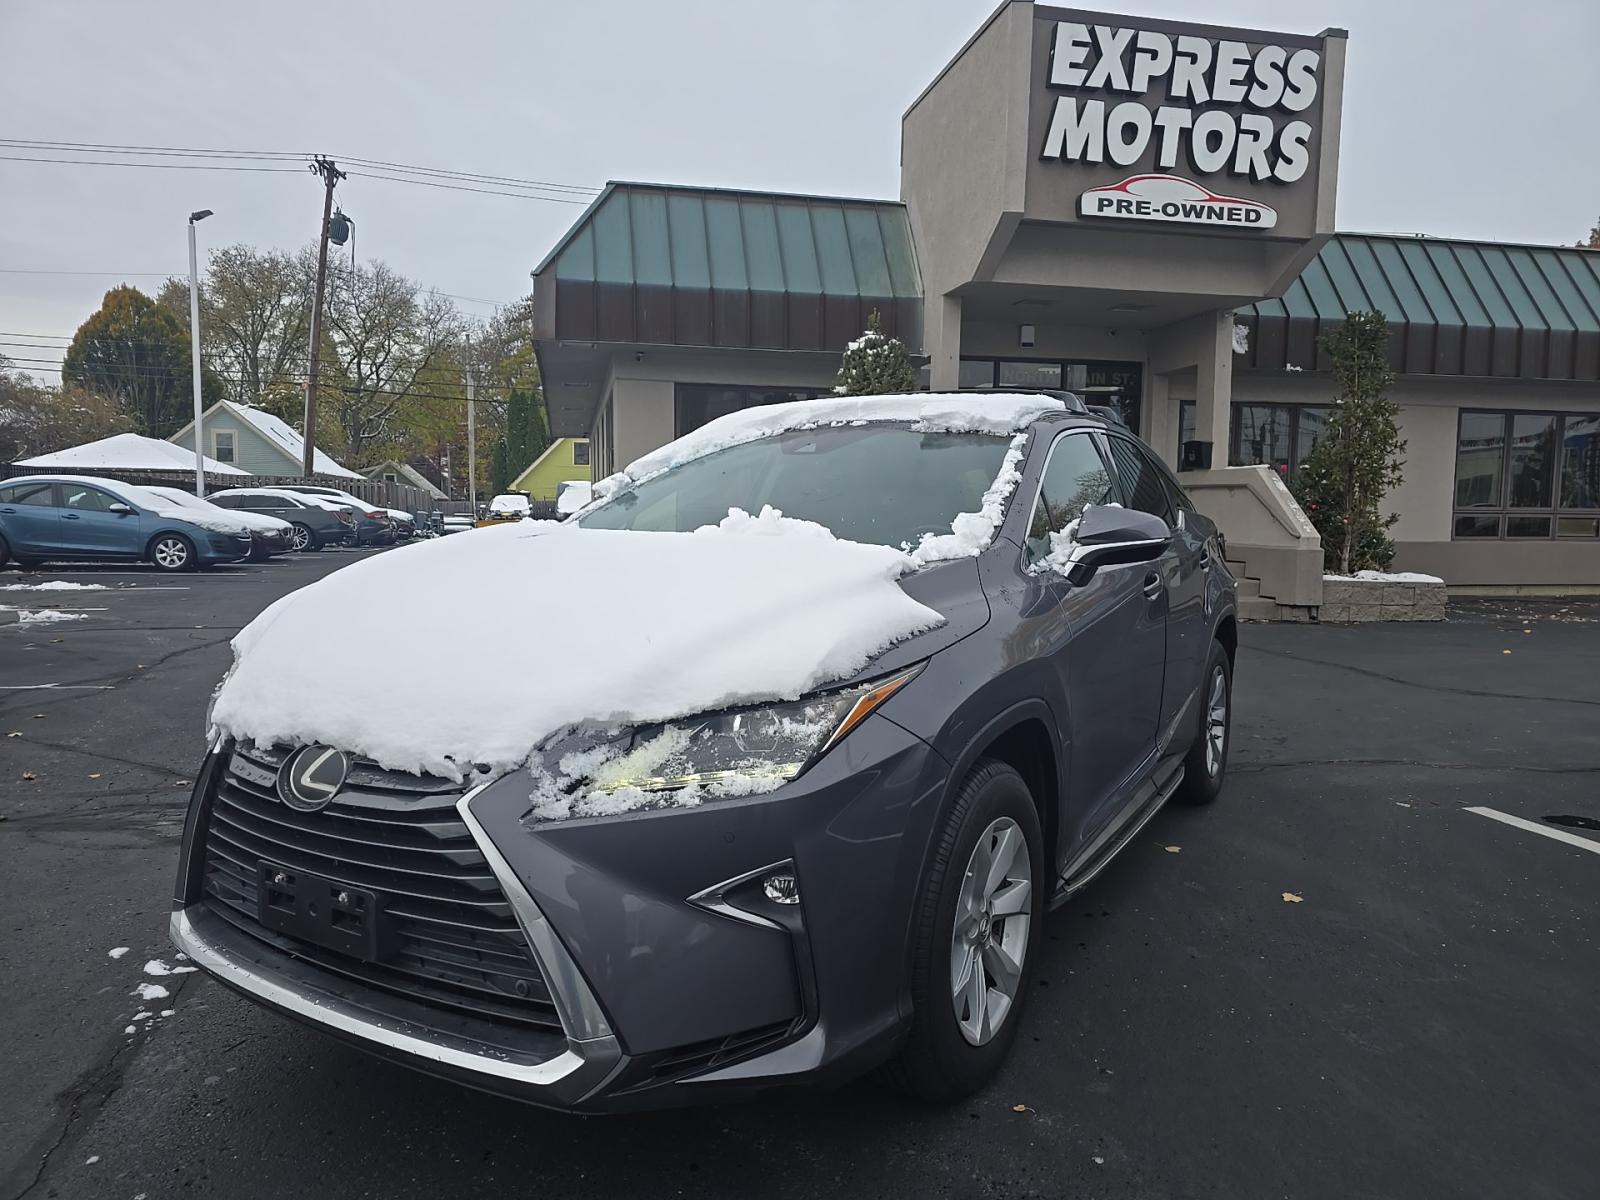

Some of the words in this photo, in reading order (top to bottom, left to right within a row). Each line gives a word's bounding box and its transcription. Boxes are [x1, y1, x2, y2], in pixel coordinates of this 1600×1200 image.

[1050, 21, 1320, 112] EXPRESS
[1042, 96, 1313, 184] MOTORS
[1097, 197, 1262, 224] PRE-OWNED
